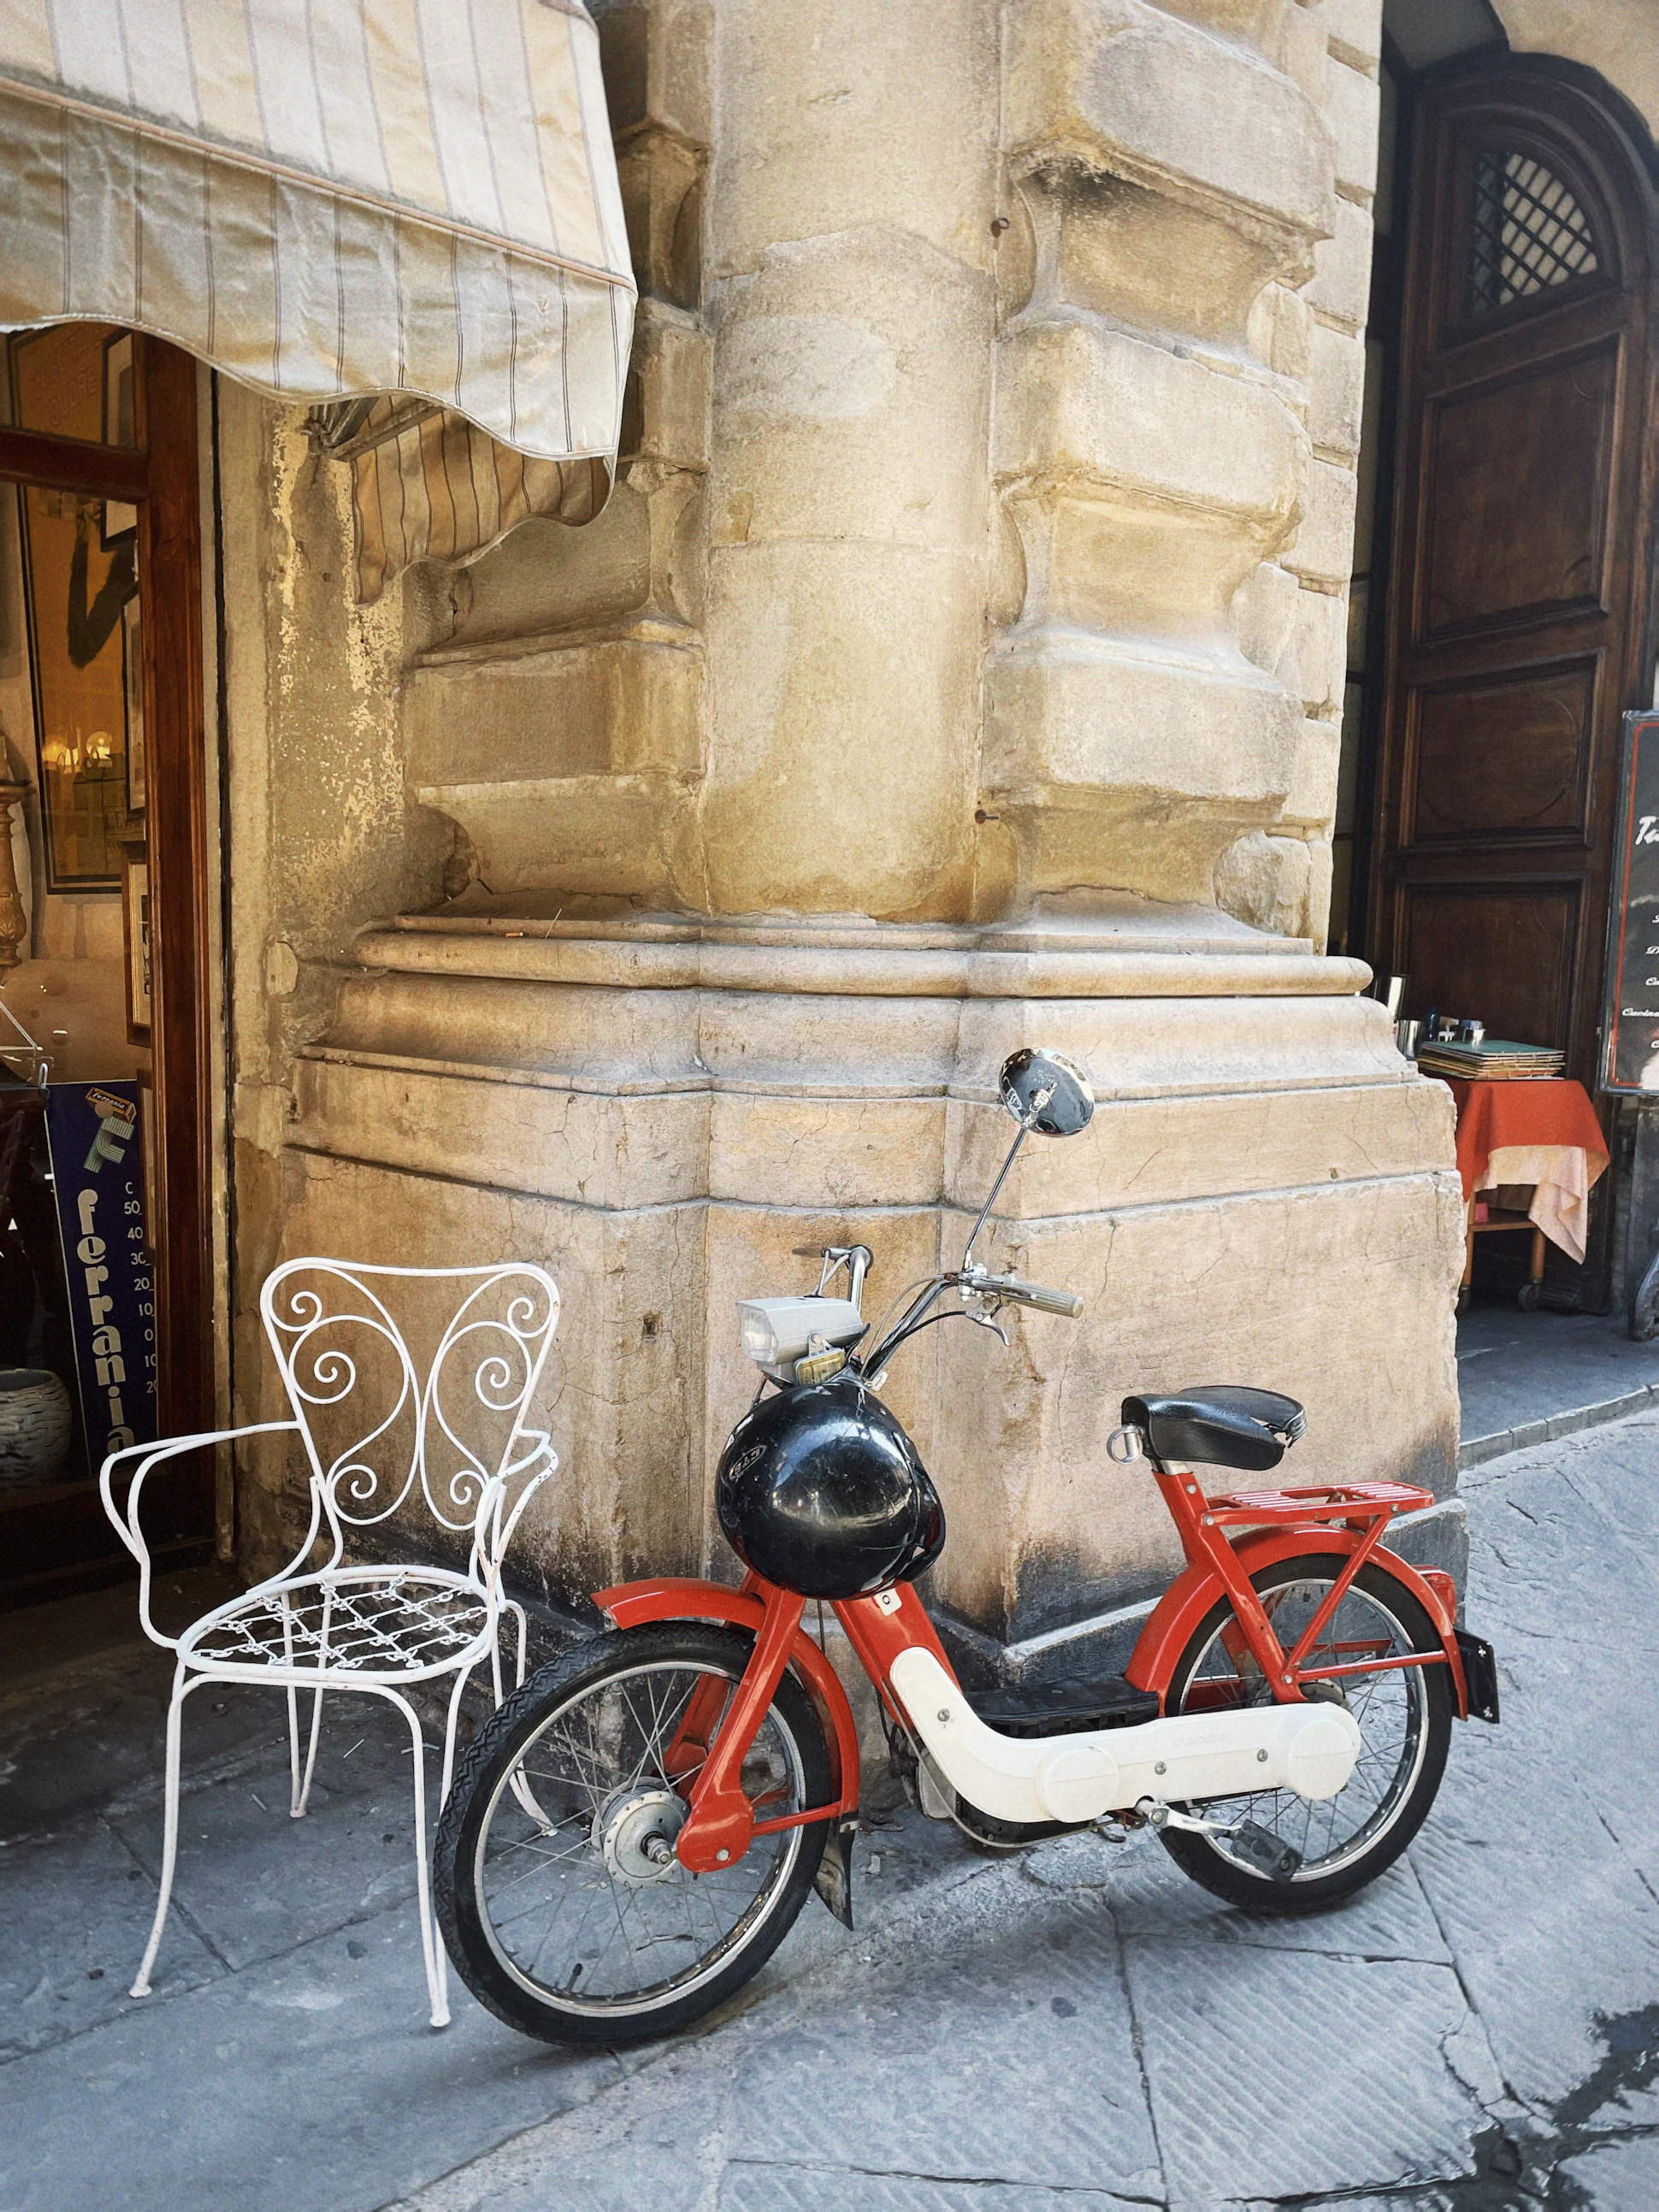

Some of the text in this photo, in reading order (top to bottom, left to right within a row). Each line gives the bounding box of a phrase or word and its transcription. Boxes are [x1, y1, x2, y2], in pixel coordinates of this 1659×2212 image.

[92, 1092, 125, 1109] ferrania
[124, 1200, 140, 1215] 50
[127, 1226, 144, 1241] 40
[133, 1277, 151, 1291] 20
[139, 1302, 153, 1317] 10
[77, 1189, 135, 1454] ferrania
[144, 1328, 154, 1342] 0
